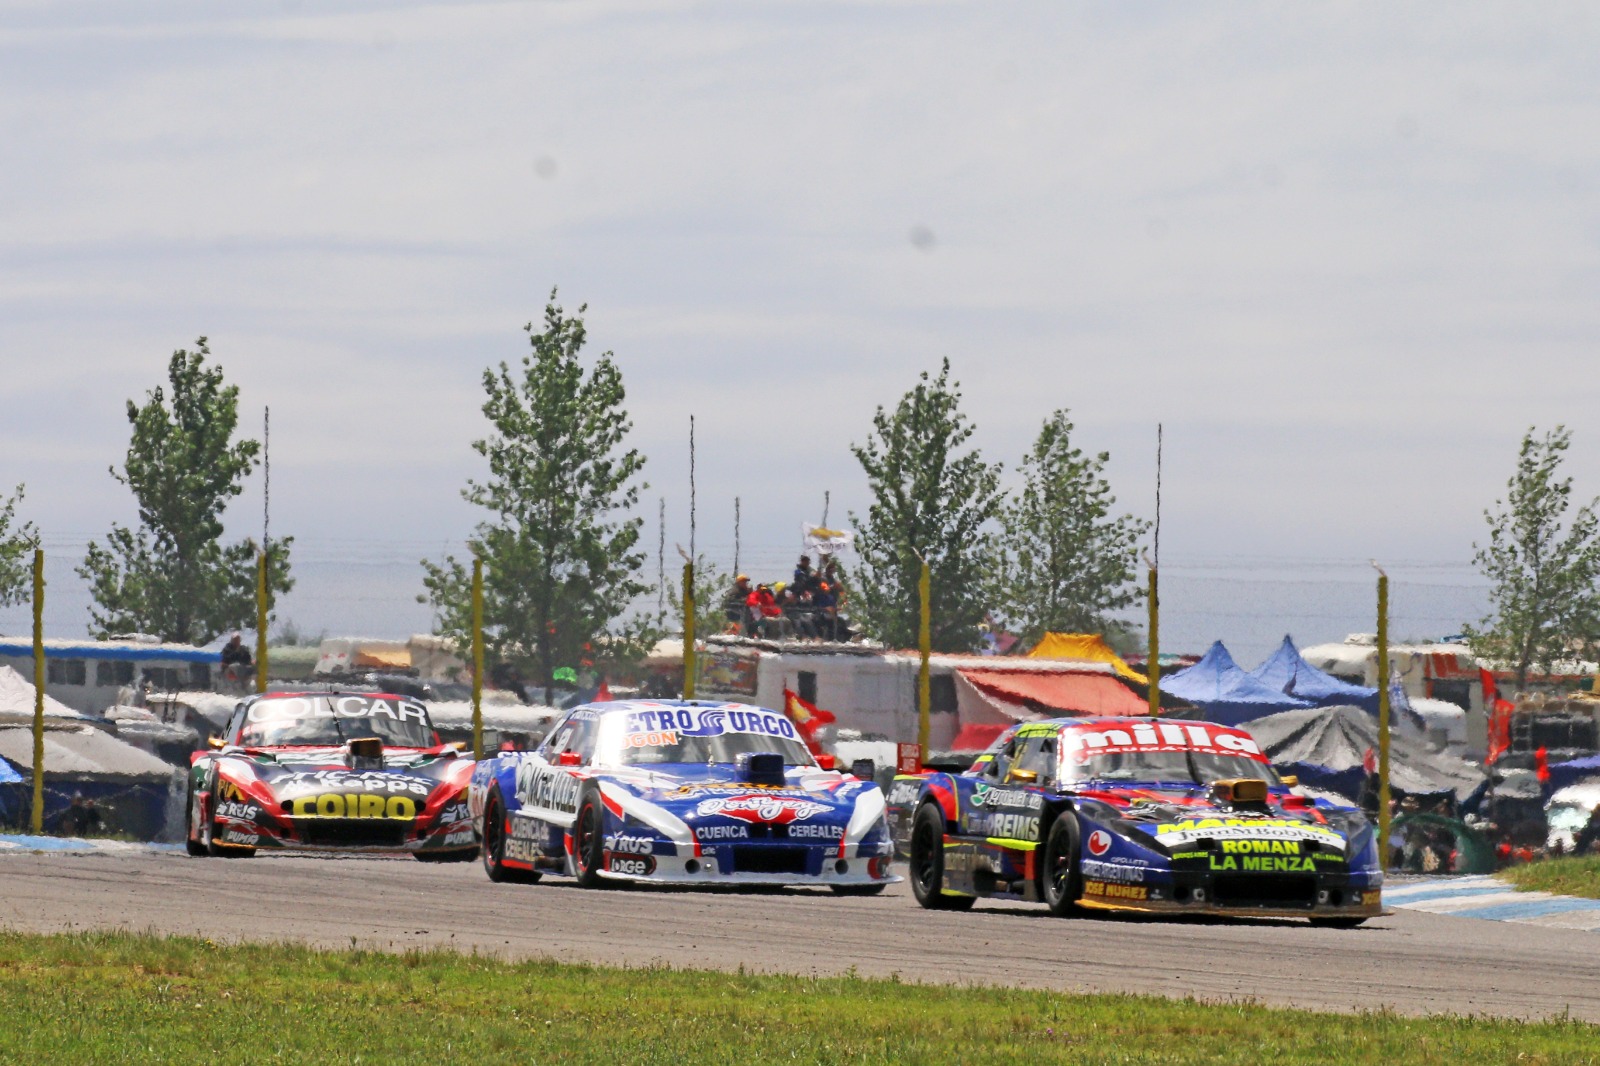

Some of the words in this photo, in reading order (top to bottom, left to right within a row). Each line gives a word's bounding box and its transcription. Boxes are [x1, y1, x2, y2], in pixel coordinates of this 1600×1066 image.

[248, 696, 427, 726] COLCAR
[320, 778, 429, 796] Kappa
[229, 802, 258, 820] RUS
[292, 793, 417, 821] COIRO
[696, 826, 748, 840] CUENCA
[788, 825, 844, 840] CEREALES
[619, 834, 655, 855] RUS
[1222, 840, 1300, 855] ROMAN
[1210, 855, 1238, 871] LA
[1243, 856, 1317, 872] MENZA
